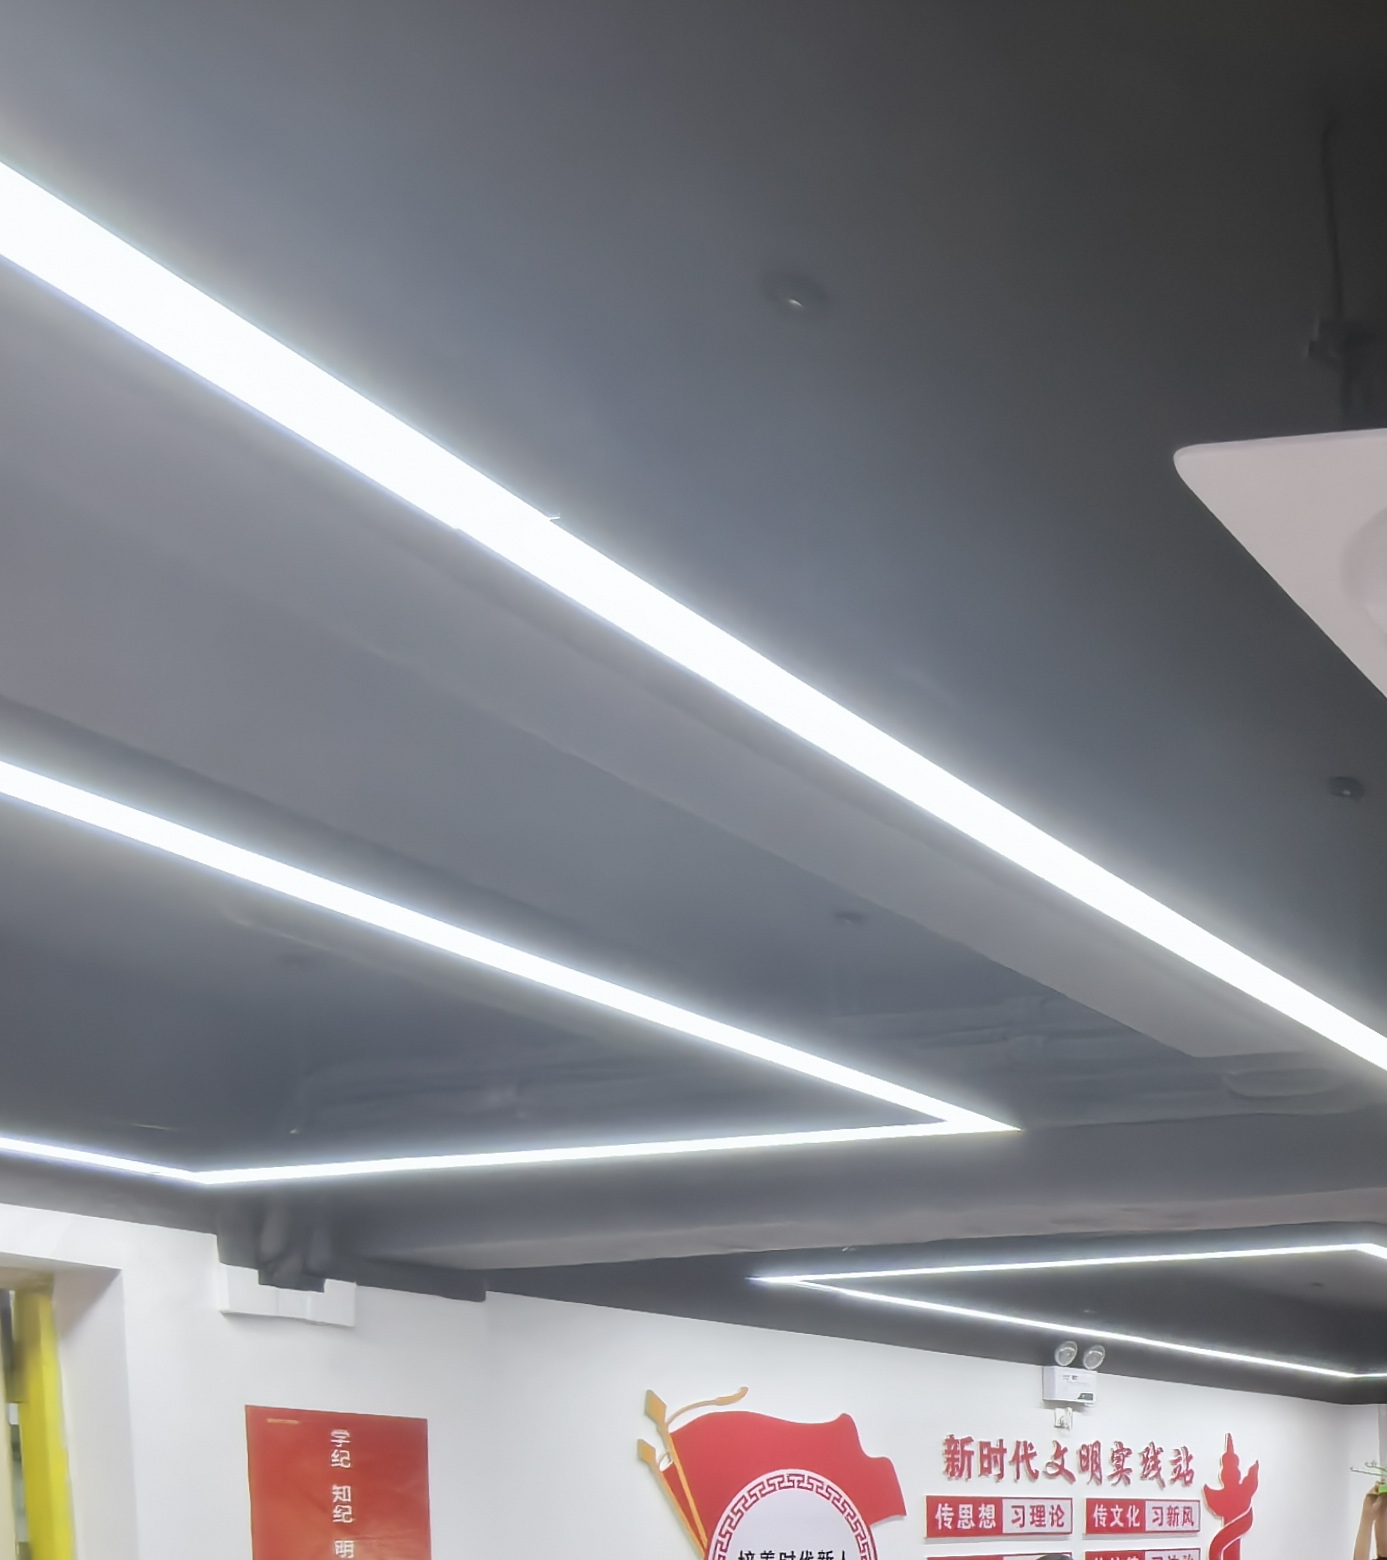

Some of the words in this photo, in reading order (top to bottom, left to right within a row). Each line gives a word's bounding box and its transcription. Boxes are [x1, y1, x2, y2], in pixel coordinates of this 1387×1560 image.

[330, 1428, 351, 1468] 学纪
[942, 1433, 1196, 1489] 新时代文明实践站
[332, 1484, 354, 1523] 知纪
[935, 1502, 997, 1531] 传思想
[1010, 1503, 1065, 1530] 习理论
[1092, 1502, 1141, 1528] 传文化
[1151, 1505, 1195, 1527] 习新风
